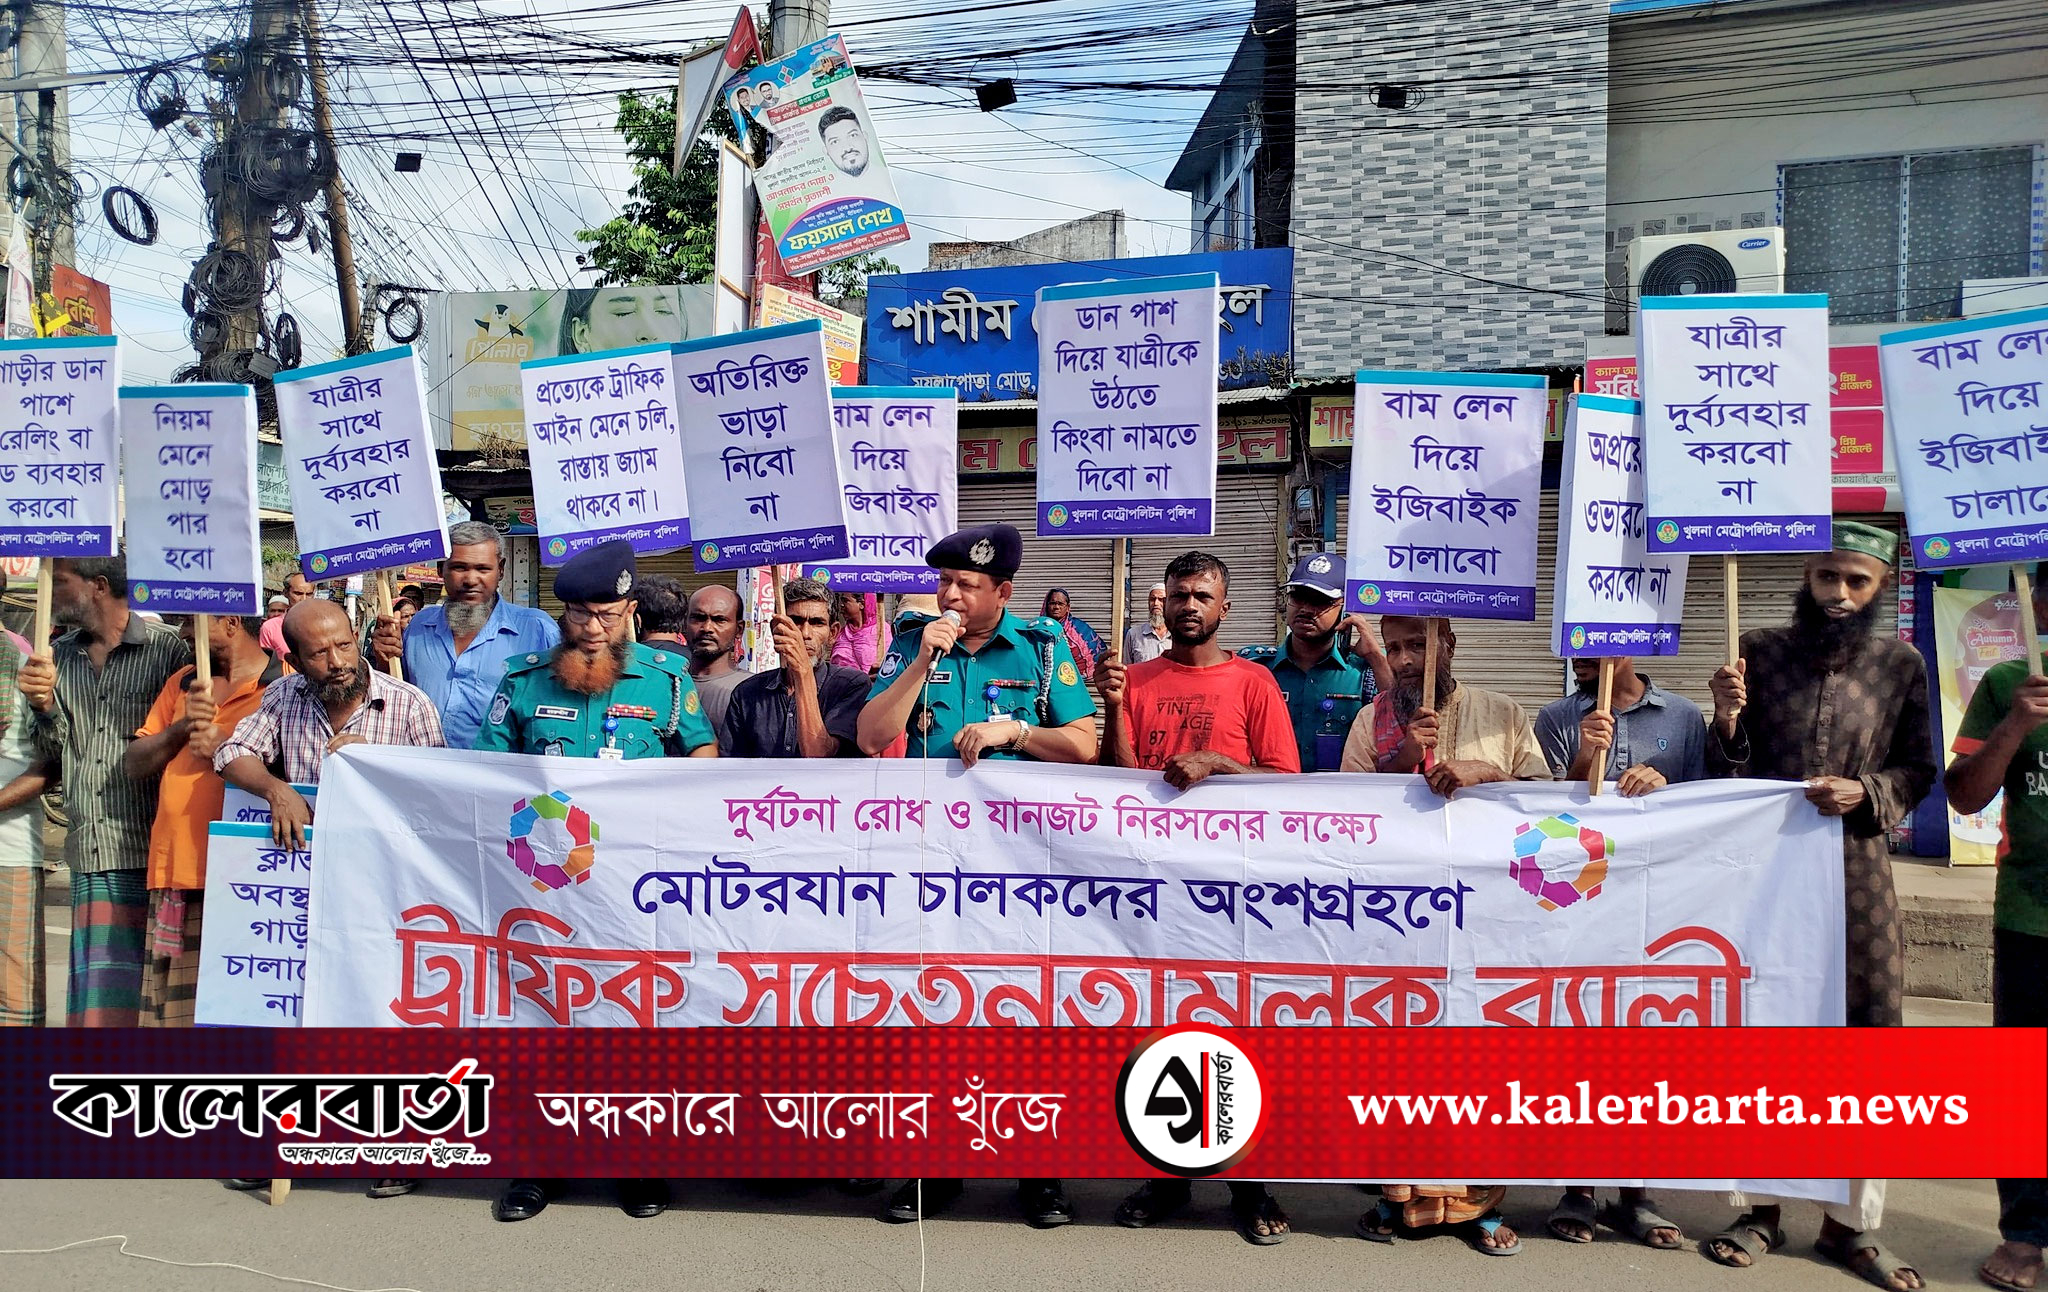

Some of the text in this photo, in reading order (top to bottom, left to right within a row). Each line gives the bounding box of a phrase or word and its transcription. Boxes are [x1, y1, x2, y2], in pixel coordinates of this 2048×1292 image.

[787, 219, 857, 250] ফয়সাল
[857, 207, 893, 231] শেখ
[1740, 239, 1767, 249] Carrier
[886, 286, 1019, 346] শামীম
[1075, 298, 1178, 331] ডান পাশ
[1685, 315, 1787, 350] যাত্রীর
[1054, 333, 1201, 373] দিয়ে যাত্রীকে
[1911, 329, 2048, 371] বাম লে
[63, 357, 107, 382] ডান
[536, 375, 605, 407] প্রত্যেকে
[607, 362, 665, 400] ট্রাফিক
[687, 354, 811, 397] অতিরিক্ত
[1694, 361, 1780, 389] সাথে
[20, 392, 75, 416] পাশে
[308, 376, 384, 408] যাত্রীর
[1090, 375, 1160, 410] উঠতে
[1381, 389, 1442, 420] বাম
[1453, 394, 1519, 422] লেন
[1954, 381, 2043, 416] দিয়ে
[153, 402, 213, 432] নিয়ম
[319, 409, 383, 438] সাথে
[533, 412, 583, 446] আইন
[589, 411, 631, 440] মেনে
[635, 399, 675, 435] চলি,
[718, 402, 788, 439] ভাড়া
[882, 405, 936, 428] লেন
[1664, 394, 1811, 434] দুর্ব্যবহার
[0, 422, 93, 451] রেলিং বা
[1051, 420, 1115, 454] কিংবা
[1121, 422, 1201, 451] নামতে
[1682, 438, 1792, 466] করবো
[1918, 424, 2048, 473] ইজিবাই
[158, 444, 214, 467] মেনে
[301, 438, 411, 480] দুর্ব্যবহার
[558, 446, 658, 483] রাস্তায় জ্যাম
[719, 445, 796, 482] নিবো
[849, 440, 910, 471] দিয়ে
[1410, 434, 1484, 472] দিয়ে
[25, 461, 105, 486] ব্যবহার
[320, 472, 402, 504] করবো
[1075, 459, 1172, 492] দিবো না
[160, 477, 213, 505] মোড়
[566, 492, 621, 522] থাকবে
[625, 486, 646, 514] না
[844, 484, 940, 517] জিবাইক
[1370, 484, 1521, 527] ইজিবাইক
[1717, 477, 1758, 505] না
[6, 495, 79, 519] করবো
[351, 509, 381, 532] না
[744, 491, 780, 523] না
[1071, 504, 1197, 524] খুলনা মেট্রোপলিটন পুলিশ
[24, 531, 74, 545] মেট্রোপলিটন
[76, 530, 101, 547] পুলিশ
[166, 511, 209, 536] পার
[569, 536, 594, 550] খুলনা
[653, 525, 679, 542] পুলিশ
[1683, 521, 1816, 540] খুলনা মেট্রোপলিটন পুলিশ
[162, 545, 215, 573] হবো
[330, 537, 431, 568] খুলনা মেট্রোপলিটন পুলিশ
[722, 532, 835, 559] খুলনা মেট্রোপলিটন পুলিশ
[1384, 542, 1502, 576] চালাবো
[1954, 536, 1989, 554] খুলনা
[833, 572, 858, 585] খুলনা
[860, 566, 915, 584] মেট্রোপলিটন
[1587, 562, 1671, 606] করবো না
[151, 586, 245, 604] খুলনা মেট্রোপলিটন পুলিশ
[1385, 588, 1520, 607] খুলনা মেট্রোপলিটন পুলিশ
[1587, 628, 1672, 647] খুলনা মেট্রোপলিটন পুলিশ
[1970, 633, 2013, 645] Autumn
[1149, 730, 1167, 745] 87
[1180, 716, 1214, 730] AGE
[723, 785, 1382, 845] দুর্ঘটনা রোধ ও যানজট নিরসনের লক্ষ্যে
[632, 855, 1476, 937] মোটরযান চালকদের অংশগ্রহণে
[388, 903, 693, 1027] ট্রাফিক
